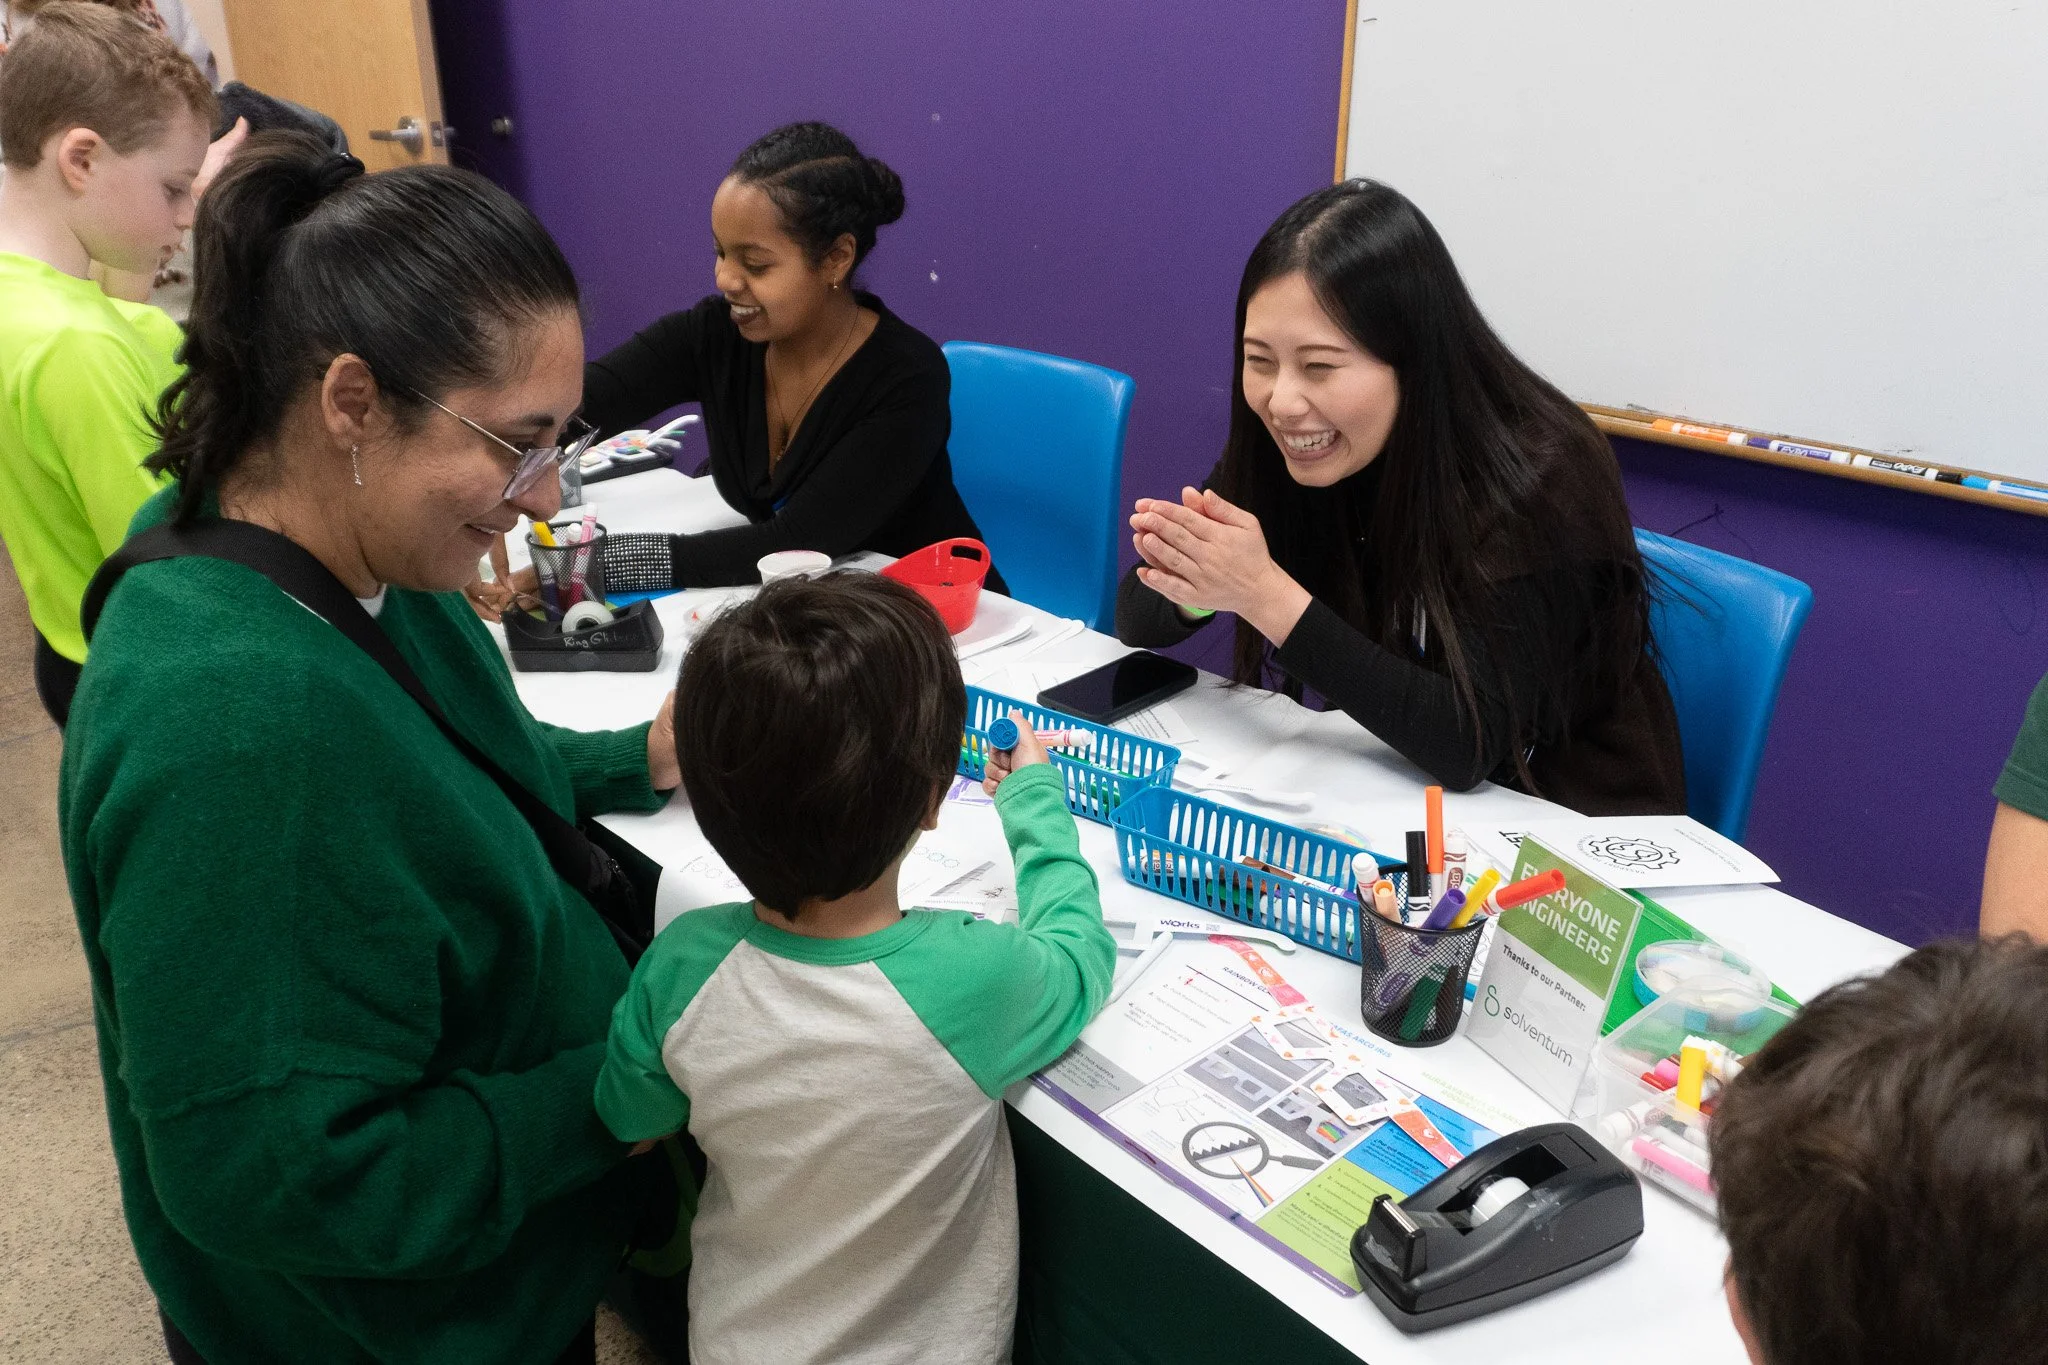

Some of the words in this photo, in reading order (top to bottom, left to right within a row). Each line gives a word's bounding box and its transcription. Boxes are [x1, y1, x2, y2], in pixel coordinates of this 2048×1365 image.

[1517, 899, 1613, 966] NGINEERS
[1503, 944, 1531, 971] Thanks
[1530, 966, 1540, 977] to
[1540, 974, 1554, 988] our
[1555, 982, 1587, 1012] Partner:
[1503, 1006, 1573, 1067] solventum
